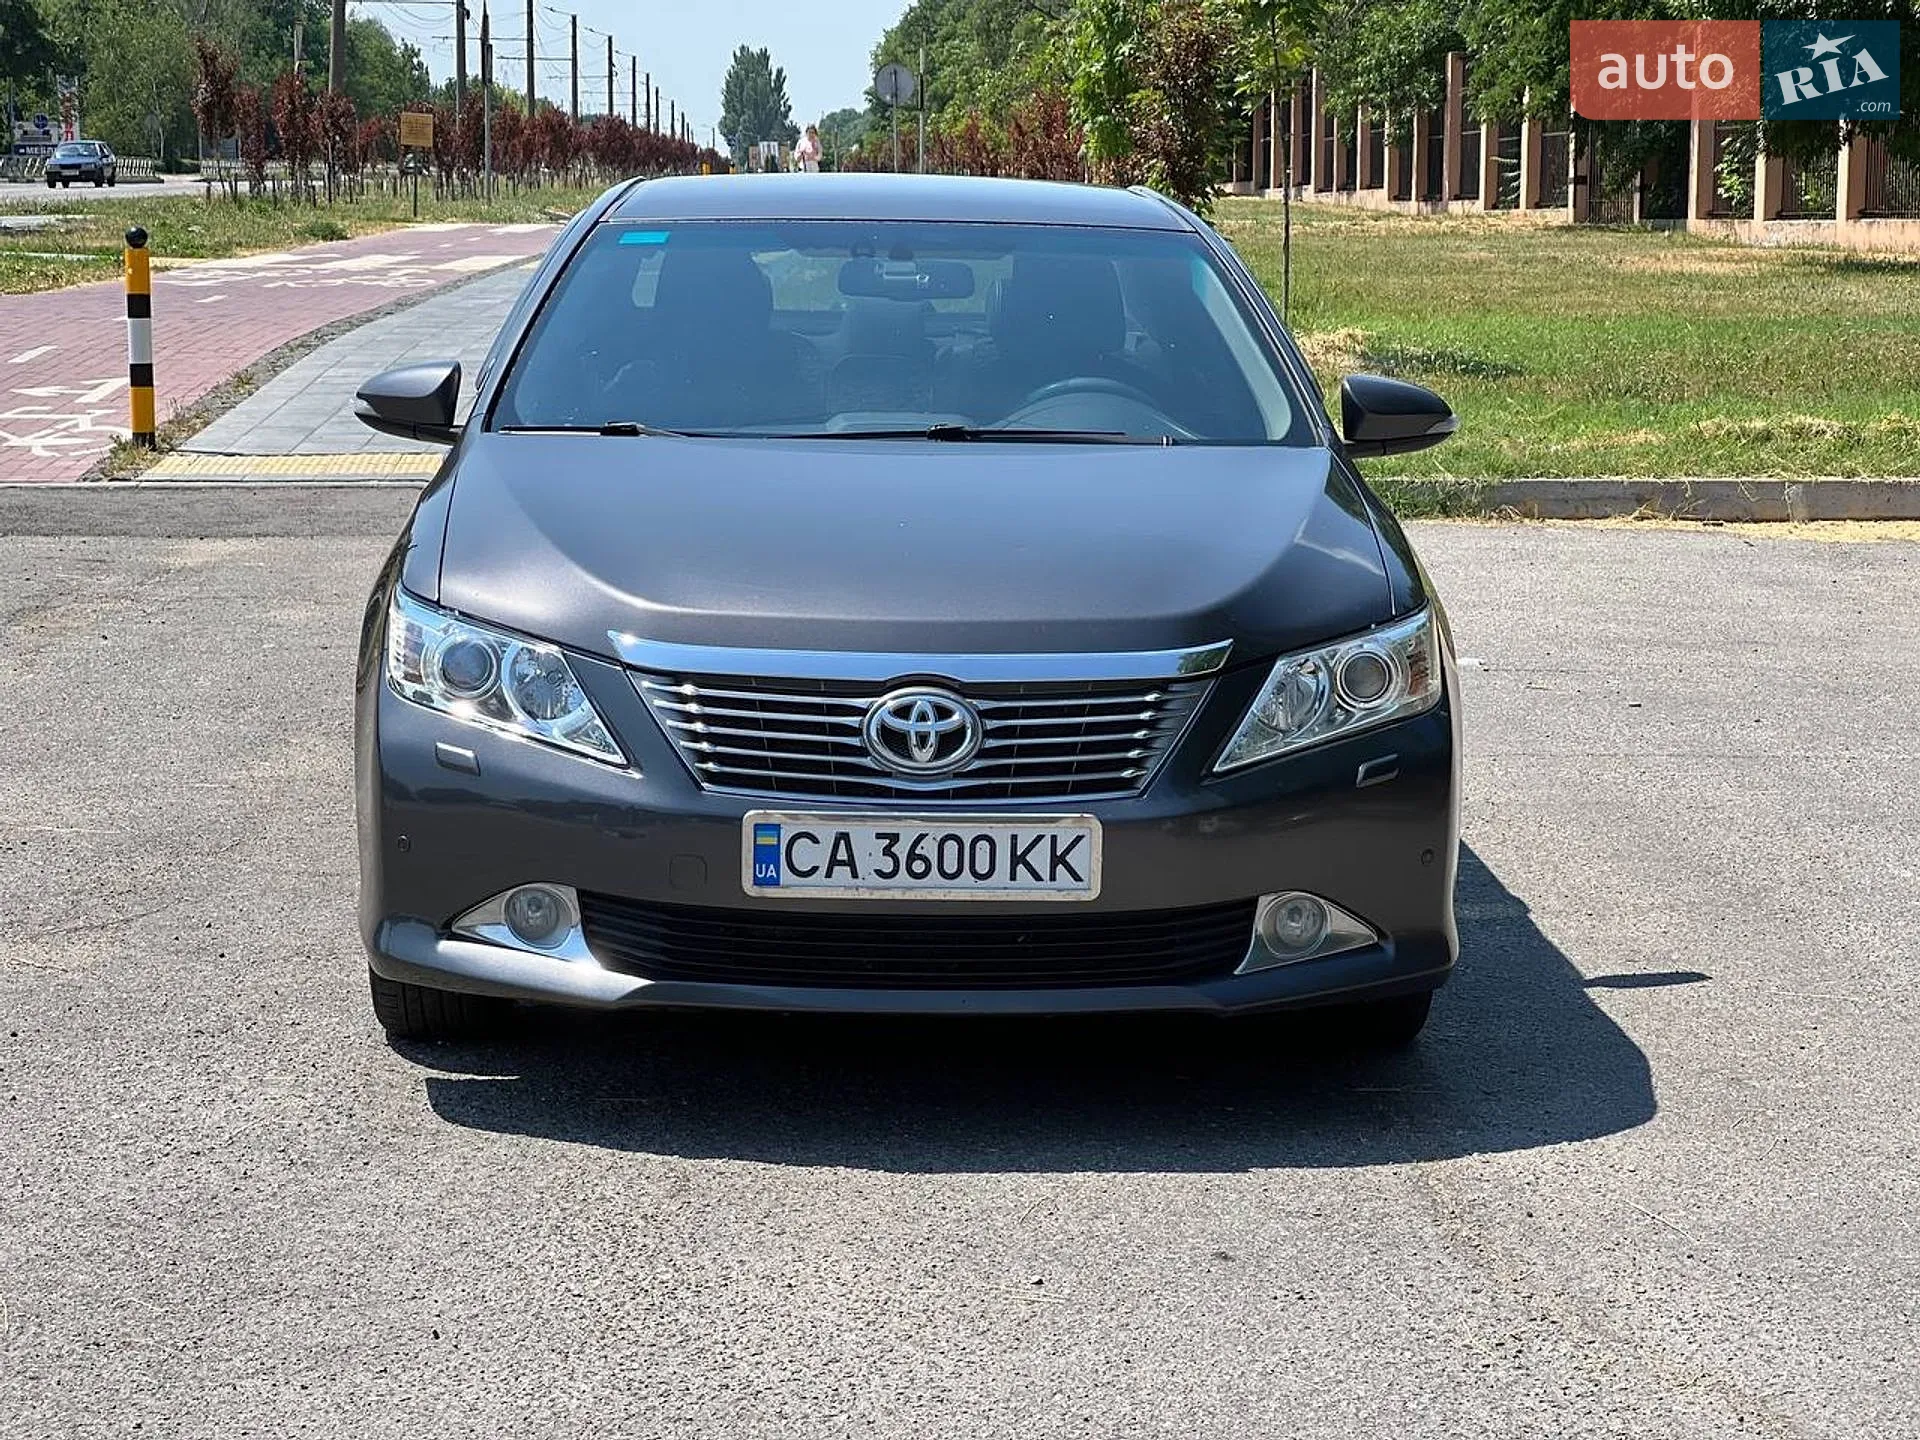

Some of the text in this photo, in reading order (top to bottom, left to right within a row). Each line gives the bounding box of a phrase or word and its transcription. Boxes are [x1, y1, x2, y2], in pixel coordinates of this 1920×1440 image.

[756, 864, 776, 878] UA
[784, 831, 1086, 882] CA 3600 KK
